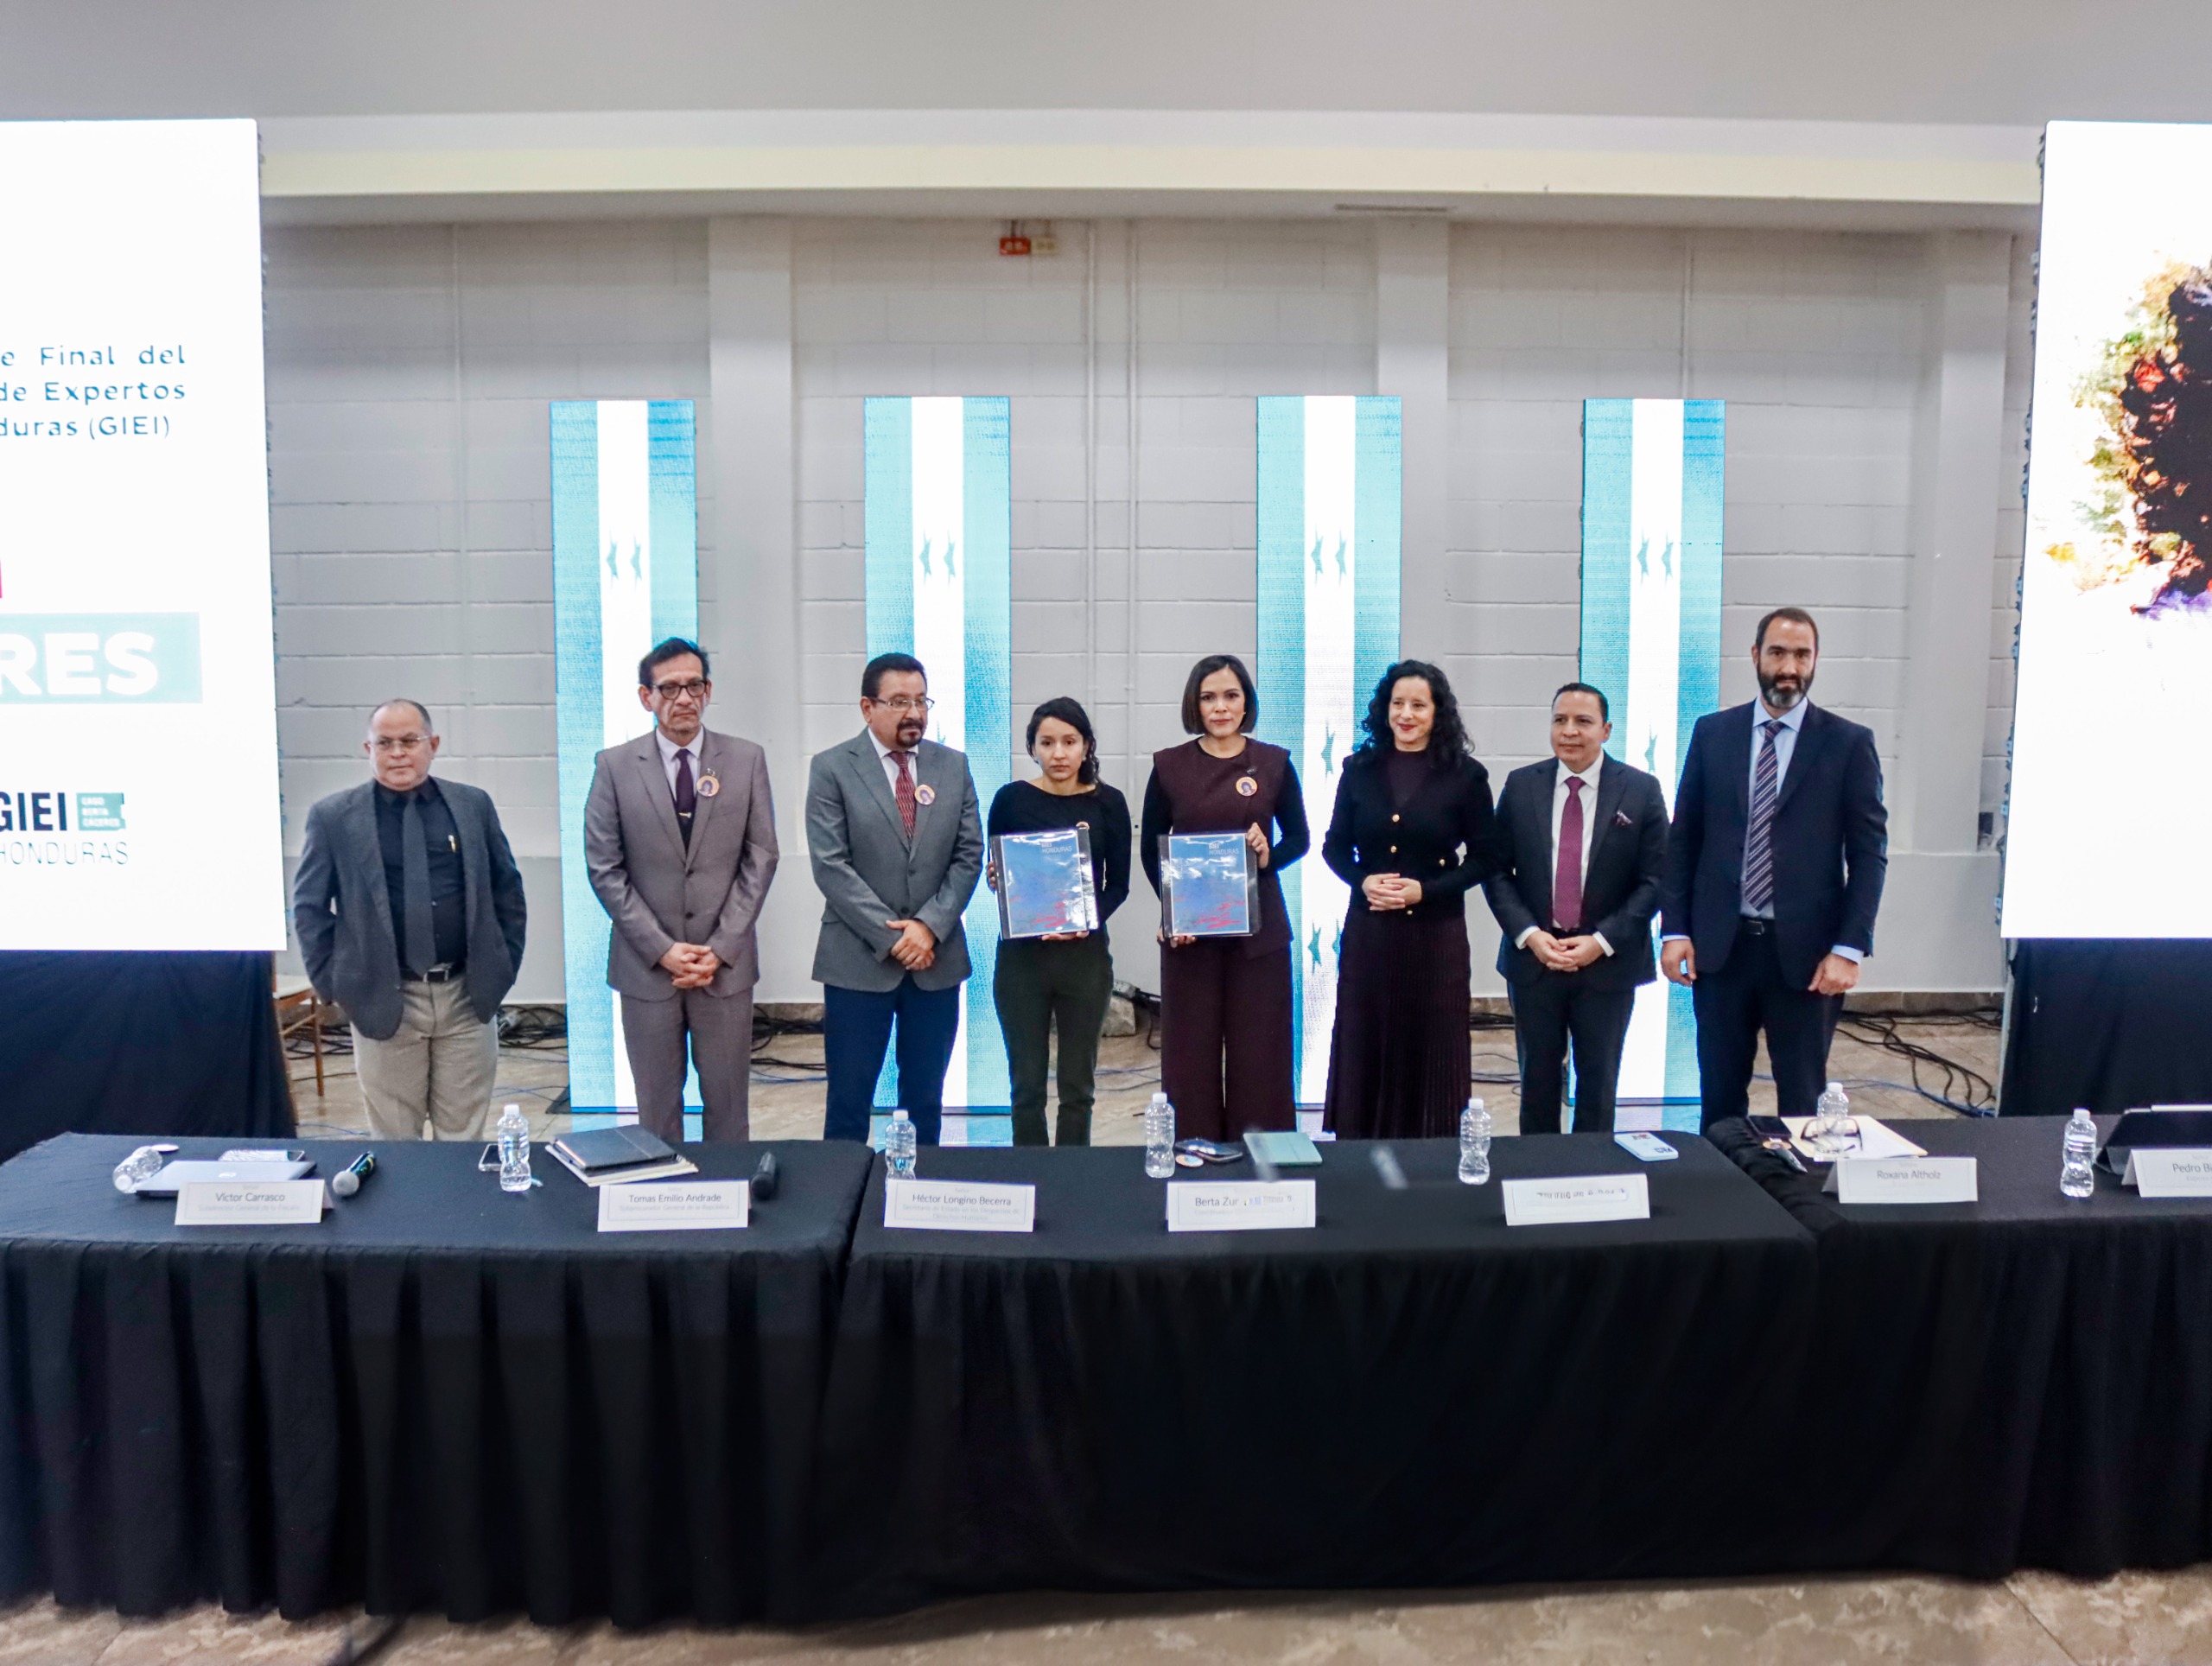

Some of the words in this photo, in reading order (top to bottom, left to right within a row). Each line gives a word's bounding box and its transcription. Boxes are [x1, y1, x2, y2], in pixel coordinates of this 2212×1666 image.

[41, 346, 114, 366] Final
[138, 345, 185, 364] del
[45, 381, 185, 405] Expertos
[89, 416, 168, 440] (GIEI)
[0, 632, 159, 696] RES
[2172, 1163, 2202, 1173] Pedro
[1877, 1170, 1908, 1180] Roxana
[1910, 1170, 1941, 1180] Altholz
[245, 1192, 285, 1202] Carrasco
[629, 1194, 656, 1203] Tomas
[685, 1193, 721, 1202] Andrade
[912, 1193, 941, 1204] Héctor
[944, 1195, 977, 1206] Longino
[979, 1196, 1012, 1206] Becerra
[1195, 1197, 1220, 1206] Berta
